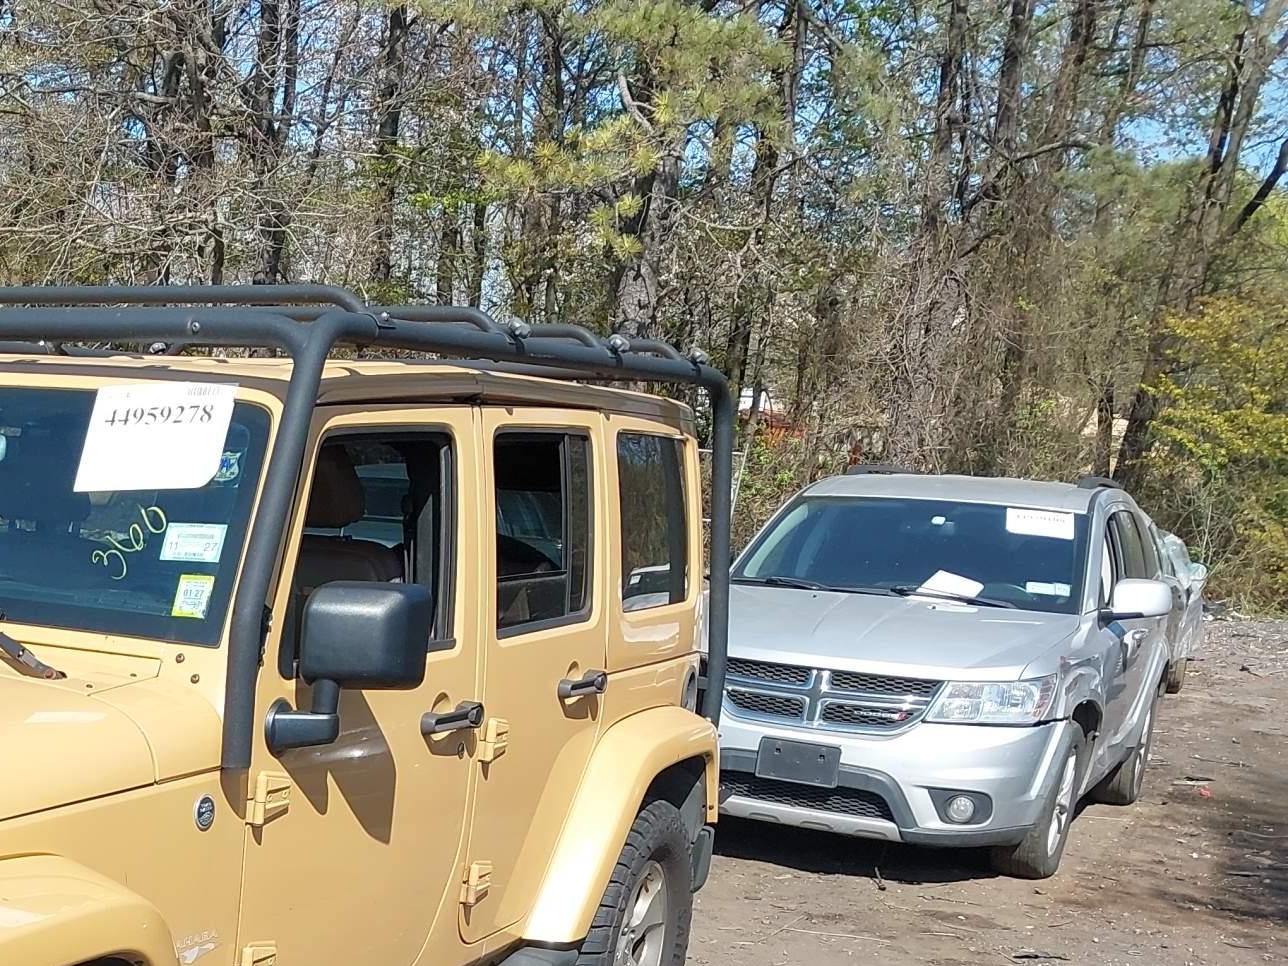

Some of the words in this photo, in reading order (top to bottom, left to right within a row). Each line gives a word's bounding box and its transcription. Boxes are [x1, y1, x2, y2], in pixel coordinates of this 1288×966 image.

[104, 404, 214, 427] 44959278
[92, 504, 167, 580] 360
[203, 542, 219, 552] 27
